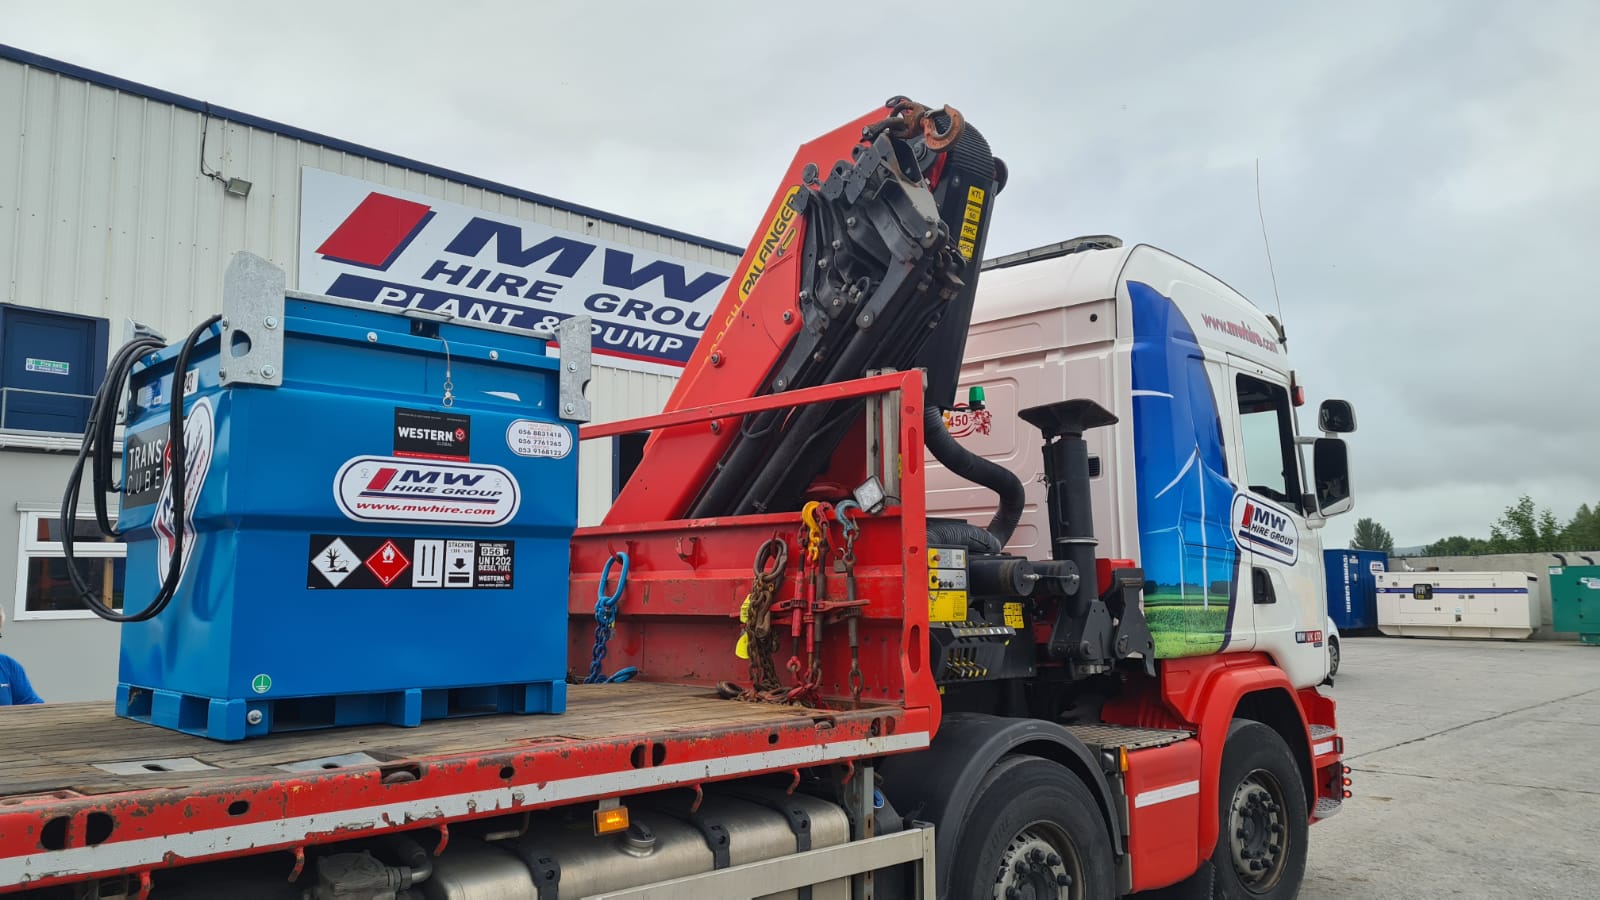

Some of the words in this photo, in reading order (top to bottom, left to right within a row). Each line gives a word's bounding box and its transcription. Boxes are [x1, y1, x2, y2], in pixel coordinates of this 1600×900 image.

[444, 216, 730, 303] MW
[421, 259, 563, 303] HIRE
[584, 293, 713, 332] GROU
[372, 286, 526, 327] PLANT
[532, 315, 560, 333] &
[591, 323, 683, 353] PUMP
[949, 414, 968, 427] 450
[397, 426, 453, 442] WESTERN
[129, 439, 162, 472] TRANS
[127, 467, 161, 496] CUBE
[399, 469, 485, 487] MW
[391, 485, 438, 494] HIRE
[441, 488, 503, 497] GROUP
[356, 502, 496, 516] www.mwhire.com
[1254, 507, 1286, 532] MW
[1251, 523, 1270, 537] HIRE
[1270, 531, 1294, 546] GROUP
[482, 547, 501, 556] 956
